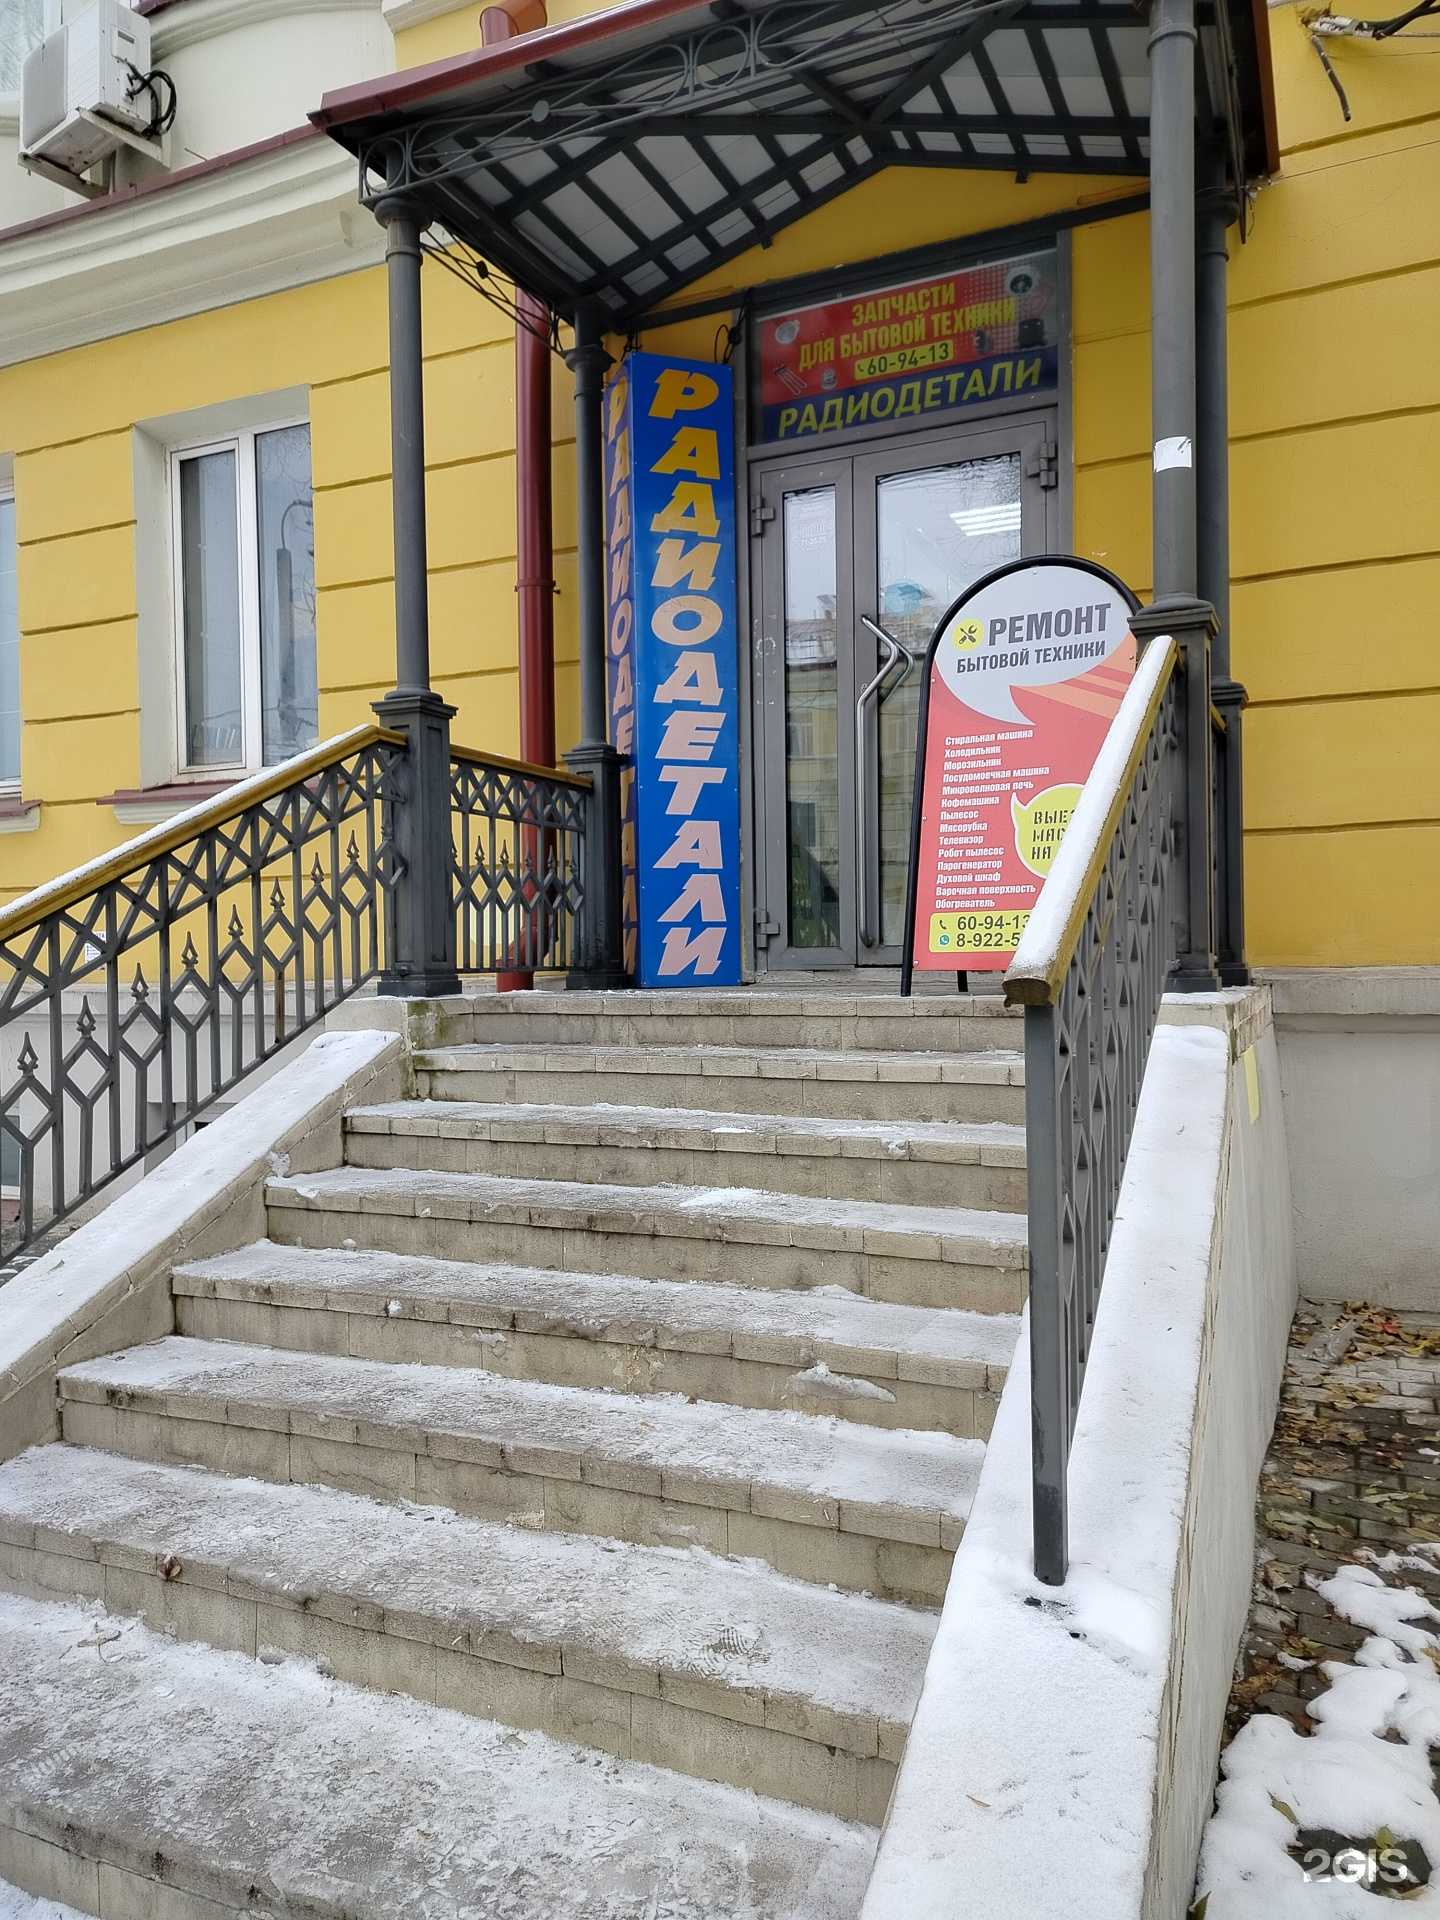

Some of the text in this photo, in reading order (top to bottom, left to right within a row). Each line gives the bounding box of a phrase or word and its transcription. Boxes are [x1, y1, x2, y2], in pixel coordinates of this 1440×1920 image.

[852, 283, 955, 327] ЗАПЧАСТИ
[800, 298, 1016, 372] ДЛЯ БЫТОВОЙ ТЕХНИКИ
[867, 342, 949, 376] 60-94-13
[779, 358, 1042, 438] РАДИОДЕТАЛИ
[988, 603, 1111, 646] РЕМОНТ
[957, 640, 1105, 674] БЫТОВОЙ ТЕХНИКИ
[648, 367, 727, 977] РАДИОДЕТАЛИ
[945, 730, 1033, 746] Стиральная машина
[944, 745, 1001, 758] Холодильник
[943, 758, 1001, 771] Морозильник
[943, 767, 1049, 783] Посудомоечная машина
[942, 780, 1034, 796] Микроволновая печь
[941, 796, 1000, 808] Кофемашина
[940, 810, 979, 821] Пылесос
[1033, 809, 1075, 825] ВЫЕ
[939, 822, 987, 833] Мясорубка
[939, 835, 984, 846] Телевизор
[938, 847, 1005, 858] Робот пылесос
[937, 860, 1002, 871] Парогенератор
[936, 872, 1001, 885] Духовой шкаф
[936, 885, 1036, 897] Варочная поверхность
[935, 899, 996, 909] Обогреватель
